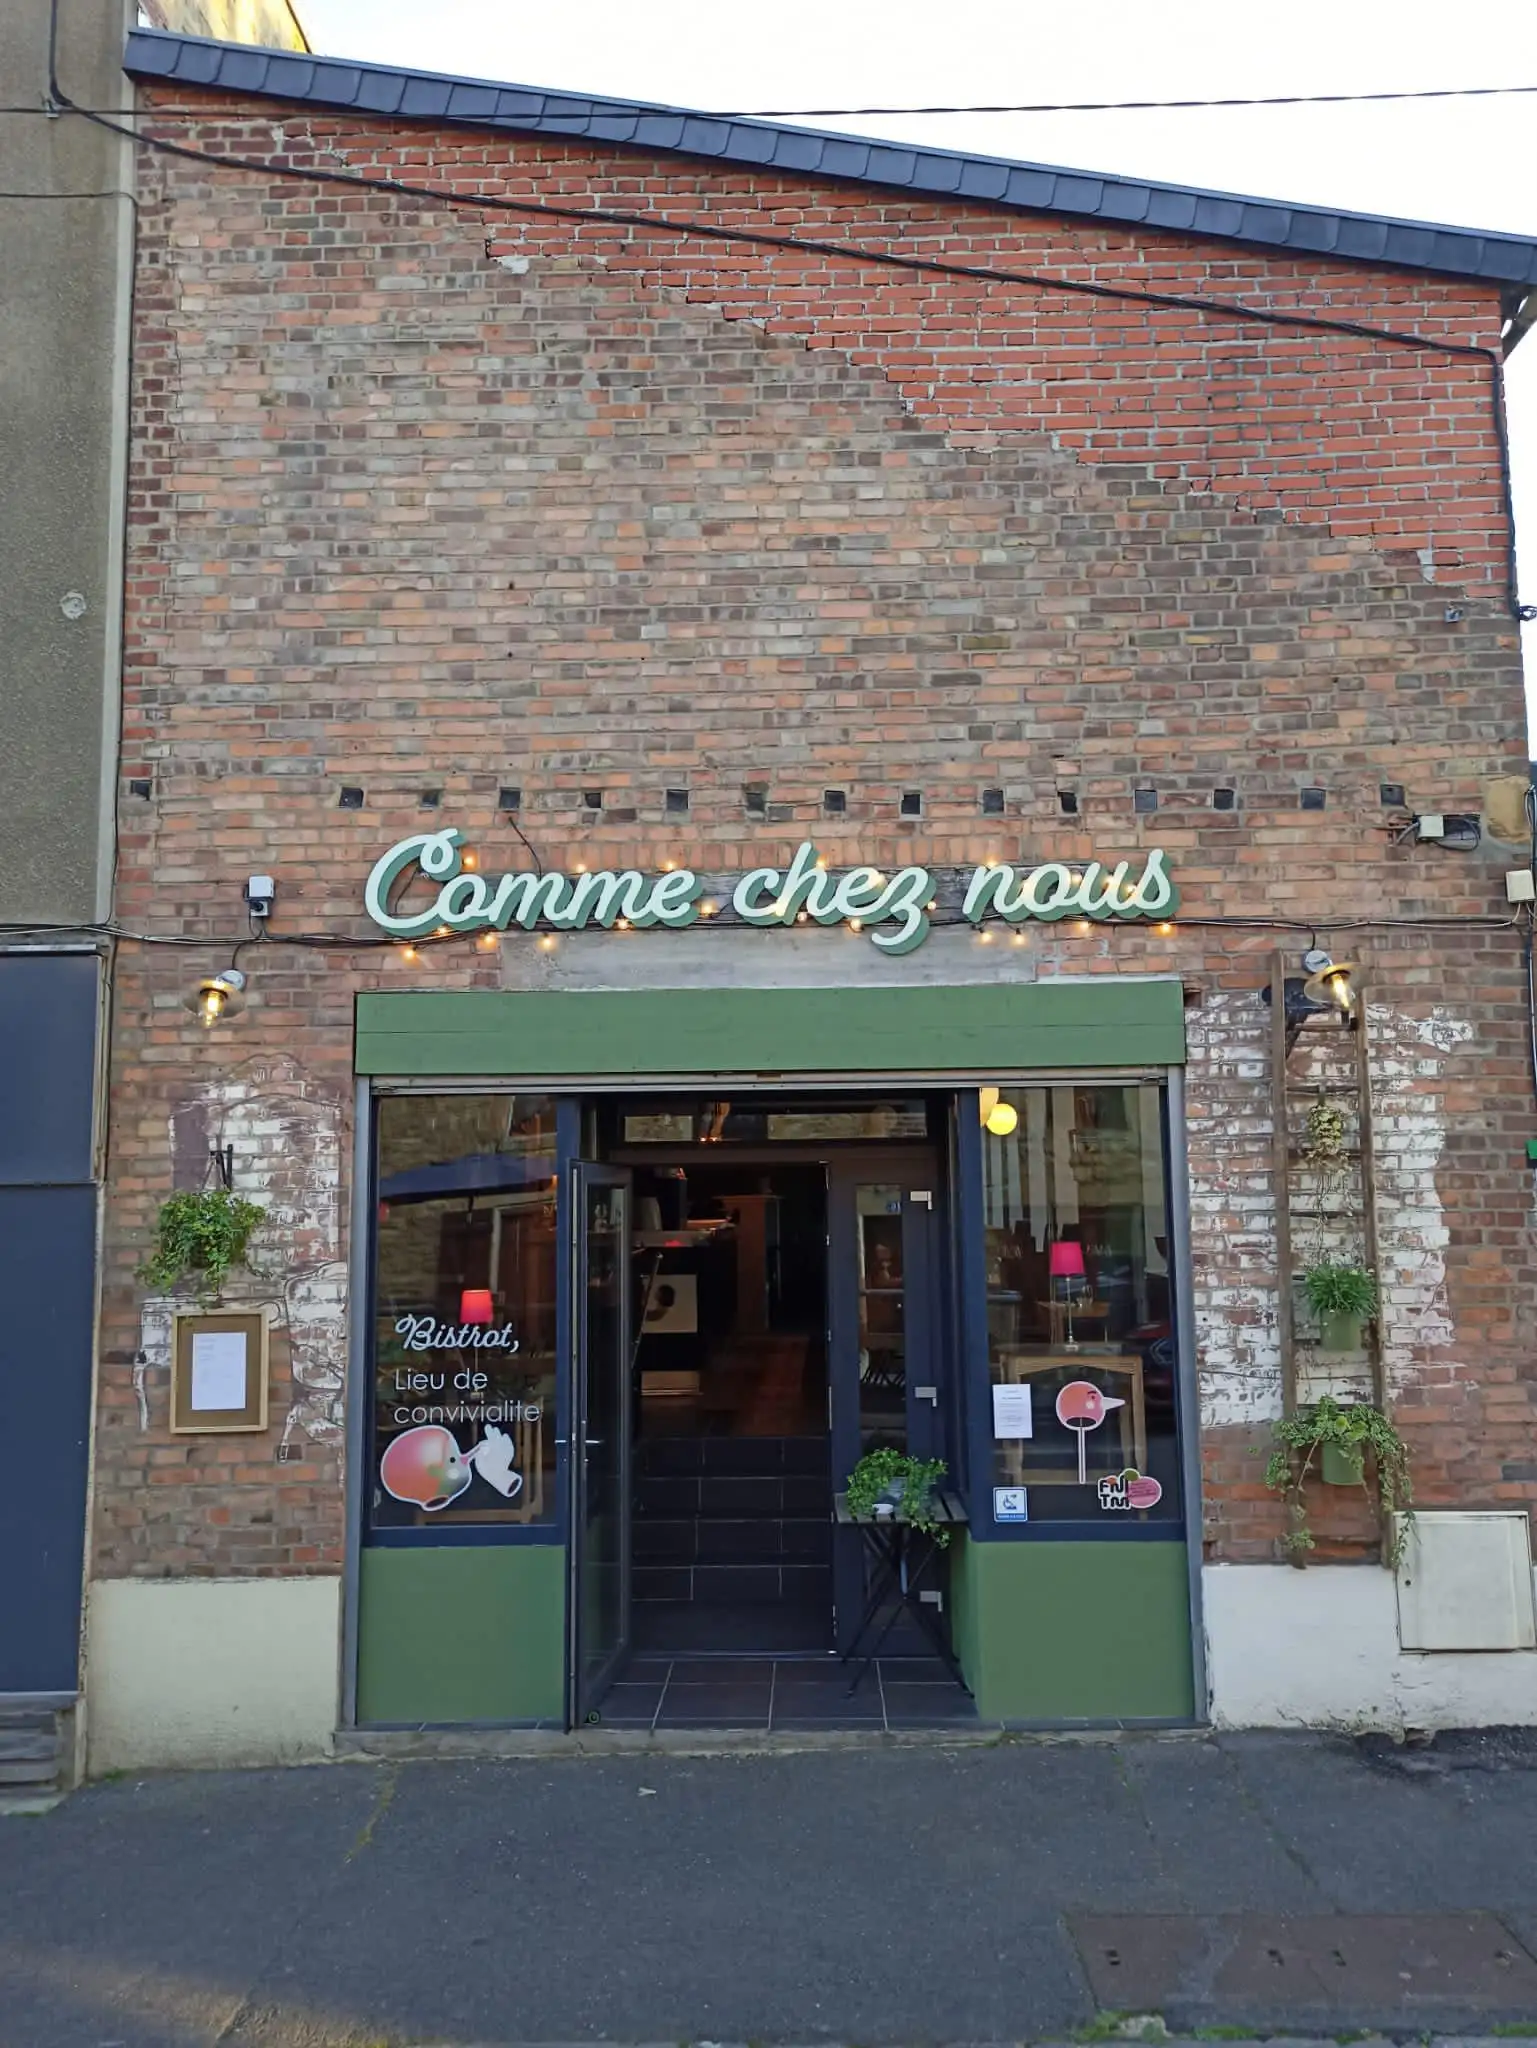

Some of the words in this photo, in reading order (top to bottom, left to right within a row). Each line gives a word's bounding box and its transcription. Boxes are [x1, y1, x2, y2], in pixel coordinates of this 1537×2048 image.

[365, 828, 703, 937] Comme
[732, 841, 937, 954] chez
[962, 848, 1181, 922] nous
[395, 1313, 519, 1353] Bistrot,
[394, 1367, 445, 1390] Lieu
[453, 1367, 488, 1390] de
